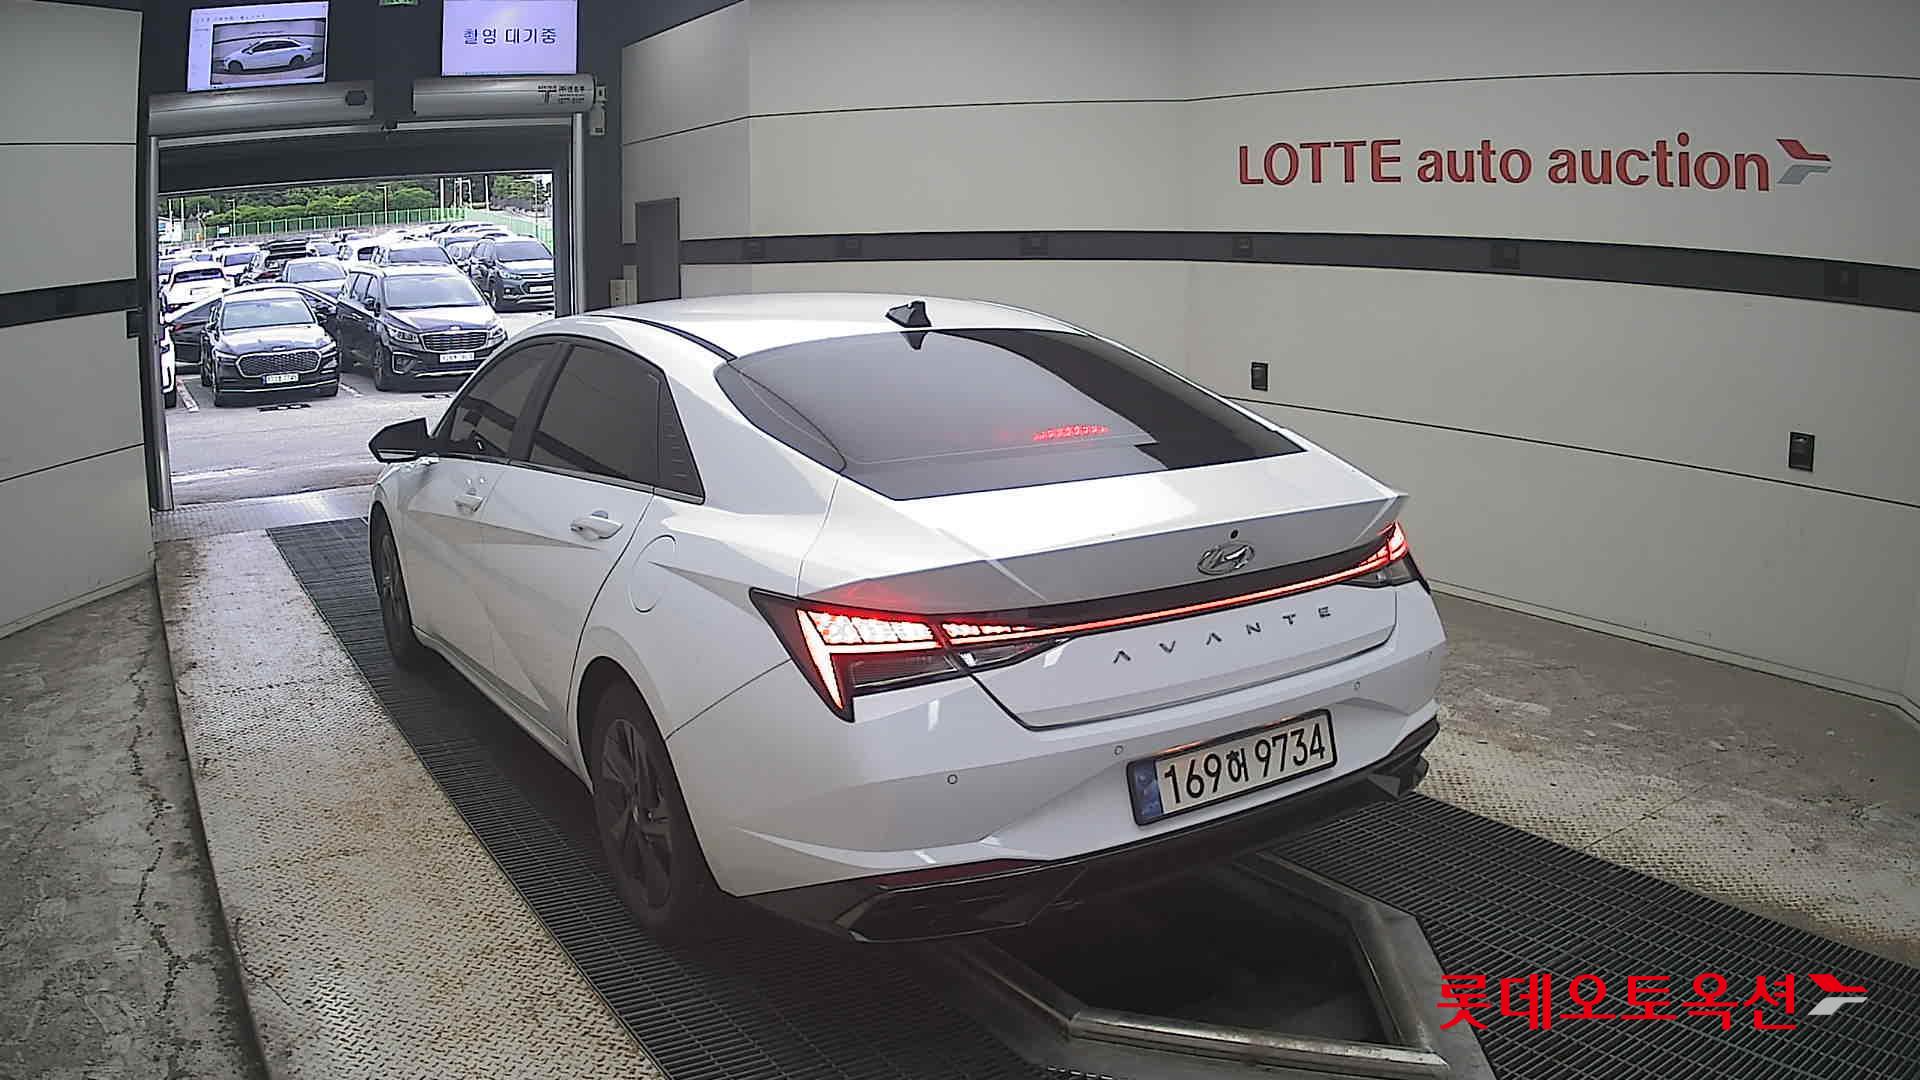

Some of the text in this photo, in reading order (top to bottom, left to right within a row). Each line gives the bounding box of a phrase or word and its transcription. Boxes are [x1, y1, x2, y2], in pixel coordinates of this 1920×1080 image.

[505, 28, 557, 45] 대기중
[1238, 132, 1769, 191] LOTTE auto auction
[1113, 606, 1331, 664] AVANTE
[1164, 747, 1249, 804] 169허
[1254, 723, 1326, 778] 9734
